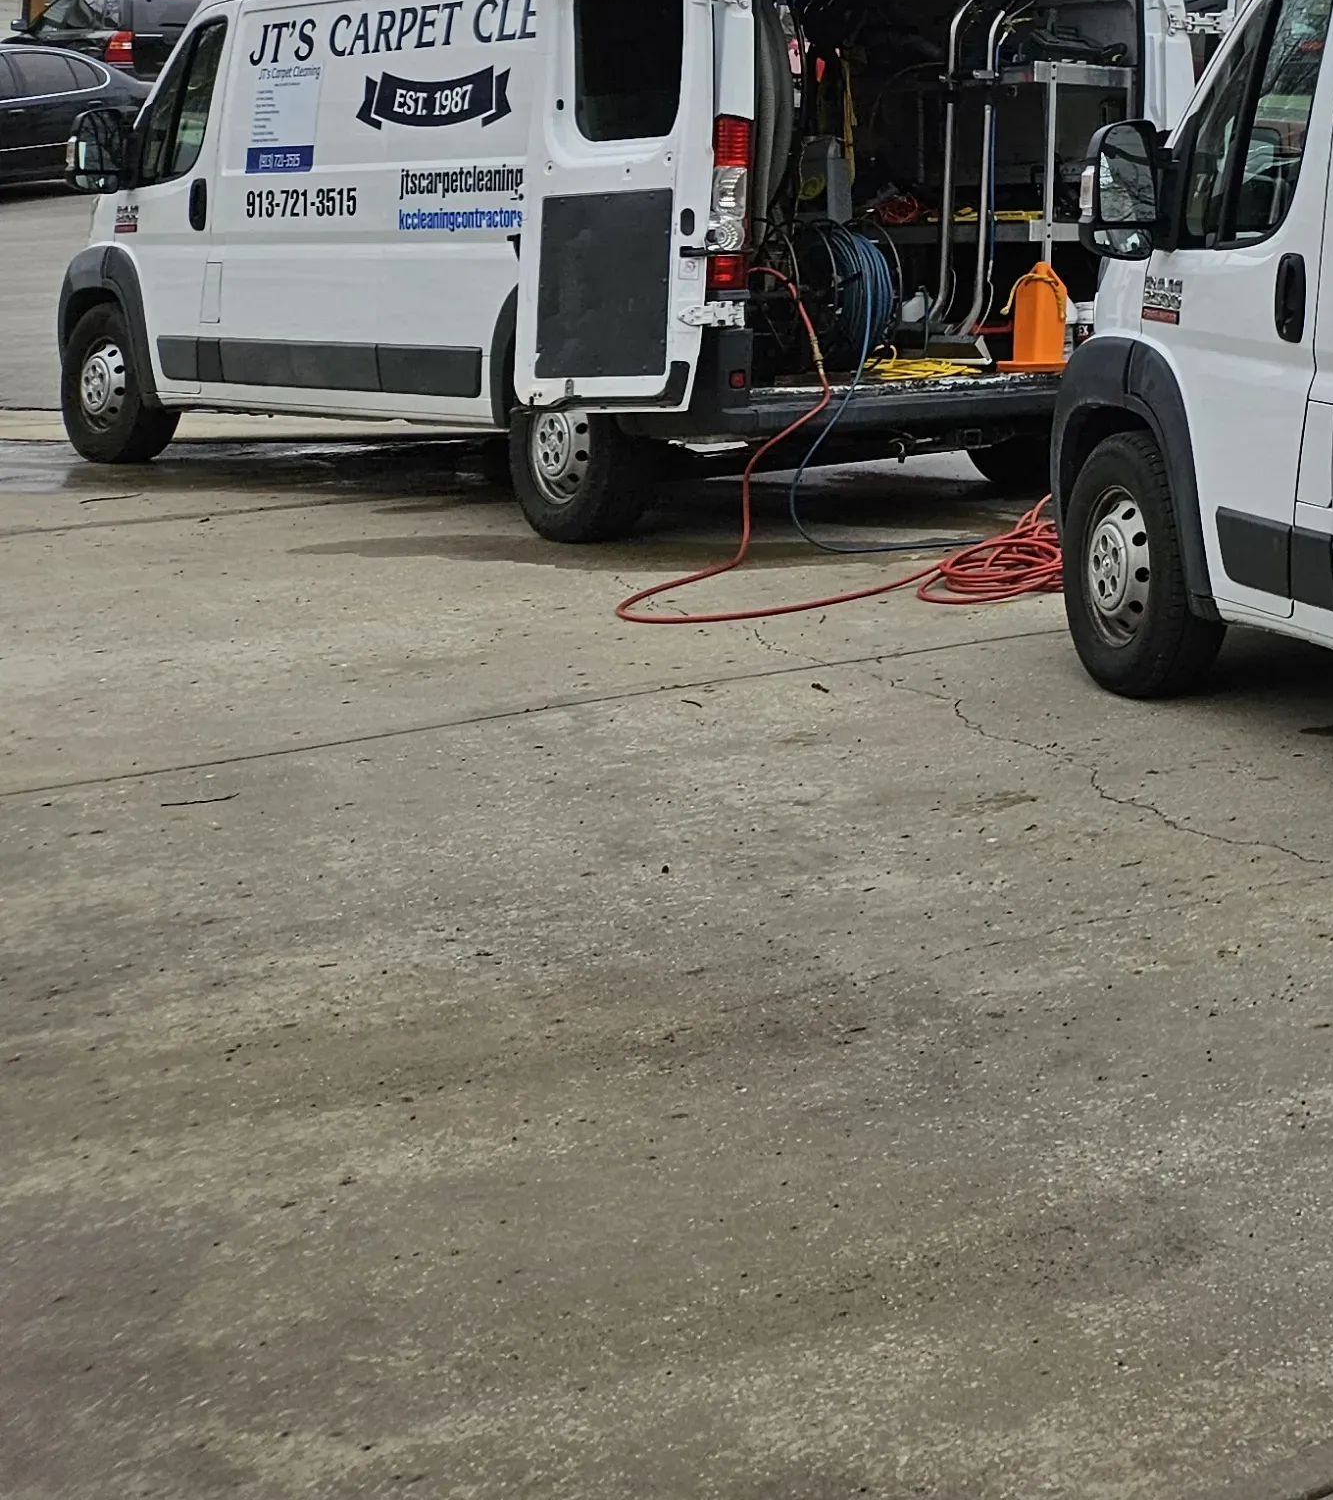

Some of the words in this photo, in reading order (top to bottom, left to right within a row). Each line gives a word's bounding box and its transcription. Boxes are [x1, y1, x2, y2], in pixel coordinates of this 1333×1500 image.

[249, 19, 316, 66] JT'S
[329, 1, 463, 57] CARPET
[393, 88, 427, 115] EST.
[433, 84, 474, 115] 1987
[399, 164, 524, 200] jtscarpetcleaning
[246, 187, 357, 218] 913-721-3515
[399, 207, 523, 232] kccleaningcontractors
